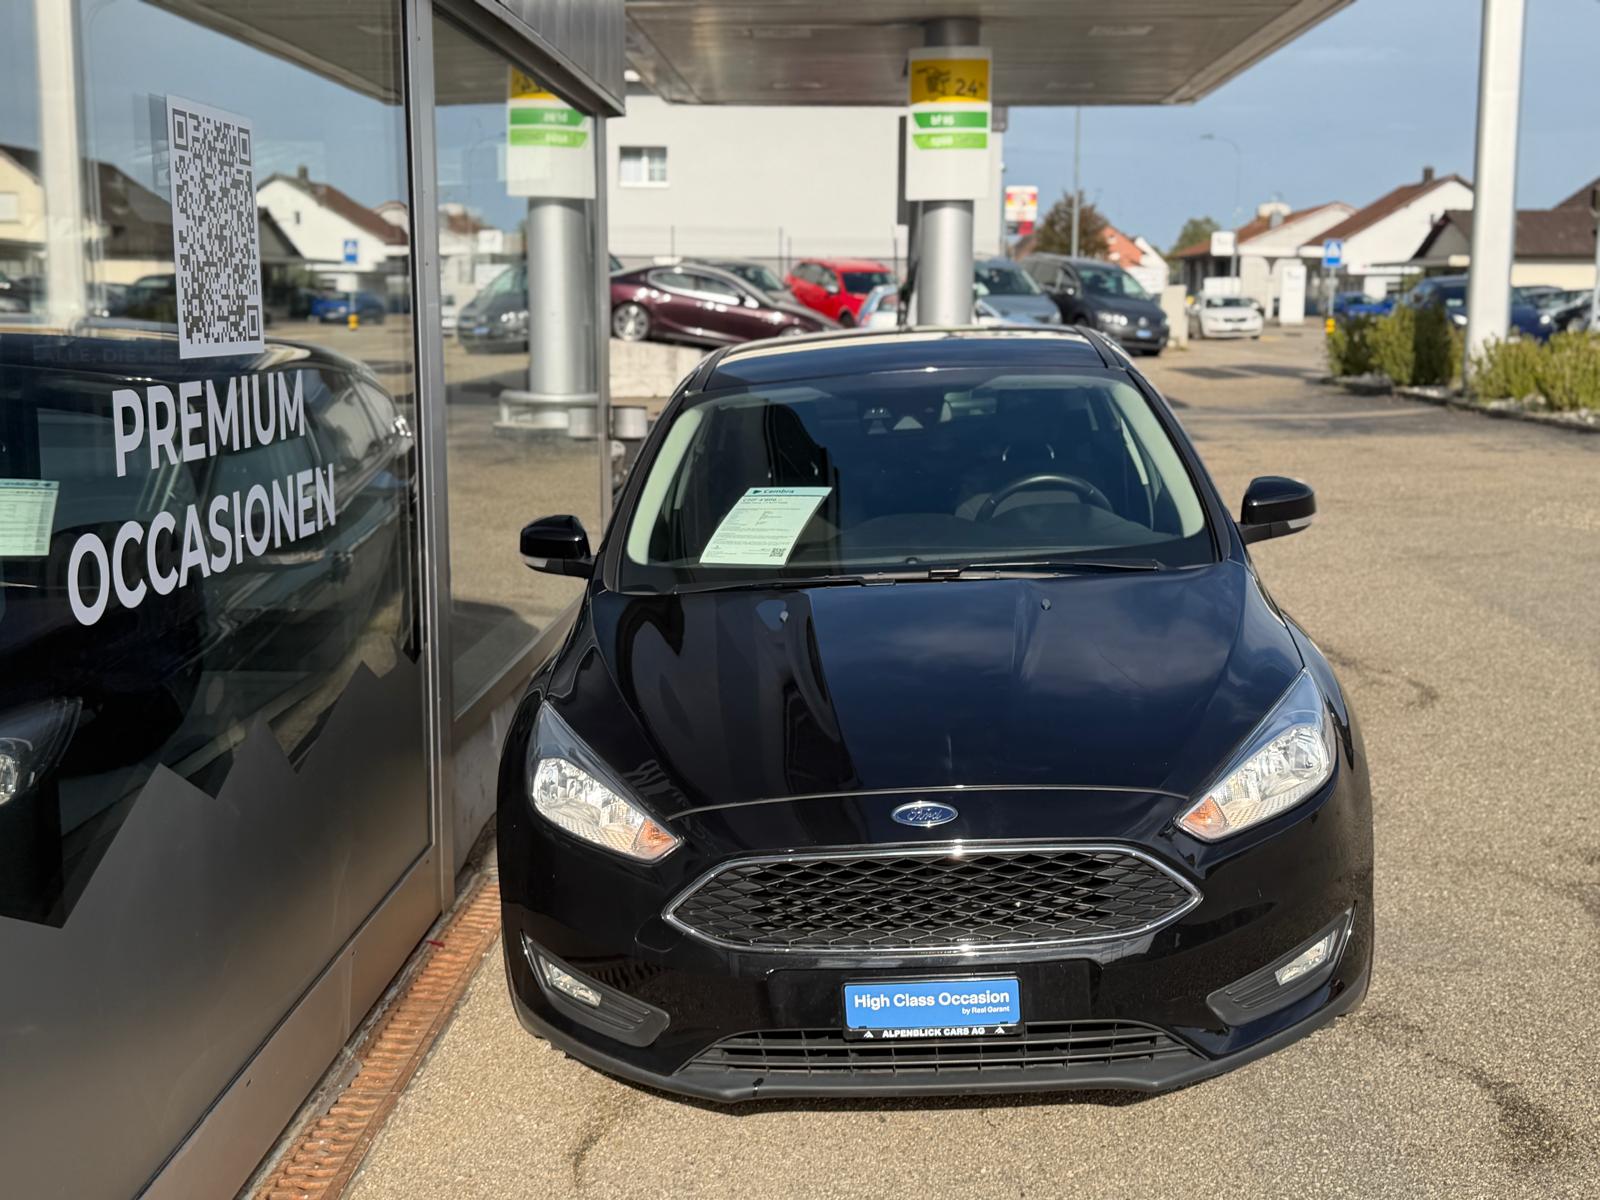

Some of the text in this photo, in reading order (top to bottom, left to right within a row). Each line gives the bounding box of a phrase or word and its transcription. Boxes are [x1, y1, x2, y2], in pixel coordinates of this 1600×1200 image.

[112, 369, 306, 478] PREMIUM
[67, 463, 336, 626] OCCASIONEN
[906, 807, 943, 821] Ford
[854, 990, 1010, 1011] High Class Occasion
[961, 1007, 971, 1015] by
[987, 1005, 1010, 1014] Garant
[882, 1027, 986, 1039] ALPENBLICK CARS AG
